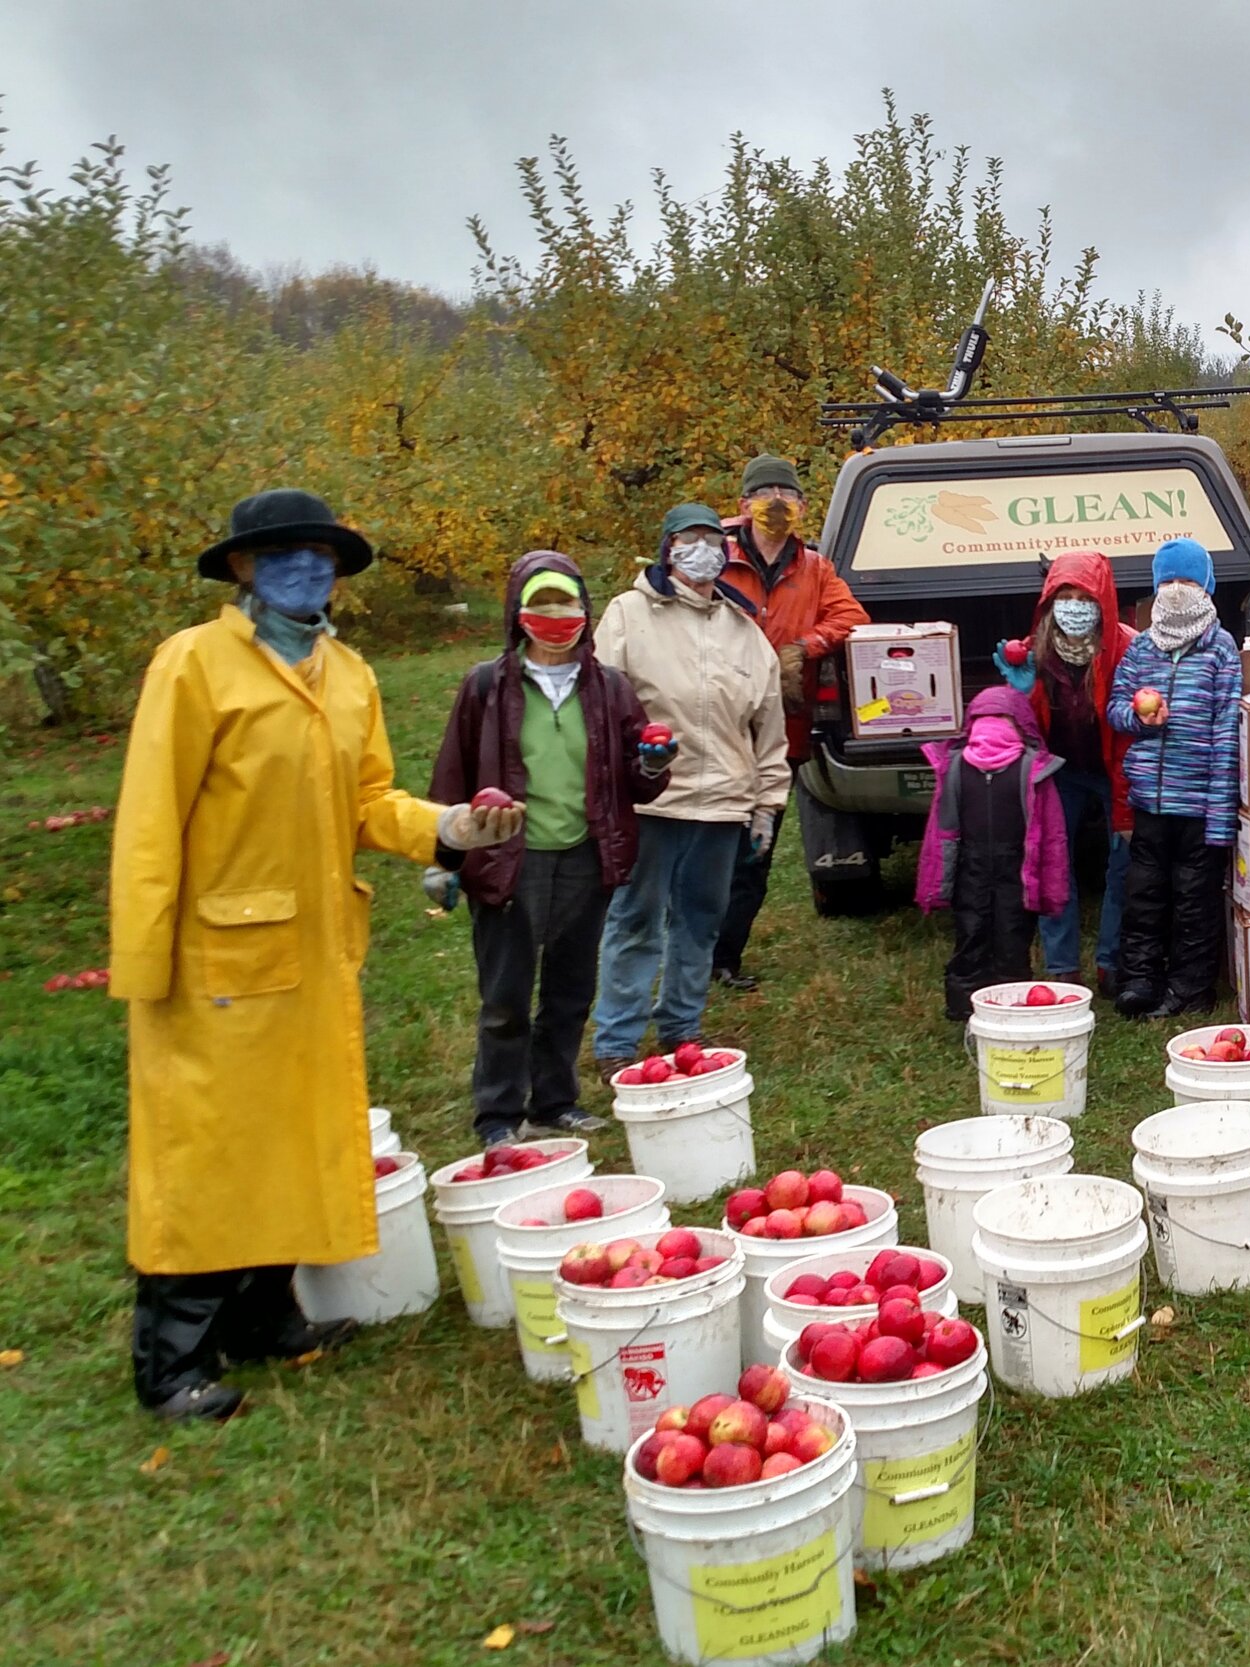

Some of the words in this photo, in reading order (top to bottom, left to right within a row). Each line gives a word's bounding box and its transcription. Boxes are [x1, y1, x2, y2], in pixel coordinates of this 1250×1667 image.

[963, 331, 980, 363] THULE
[1007, 489, 1188, 527] GLEAN!
[942, 531, 1193, 555] CommunityHarvestVT.org
[705, 1570, 780, 1587] Community
[739, 1618, 810, 1646] GLEANING
